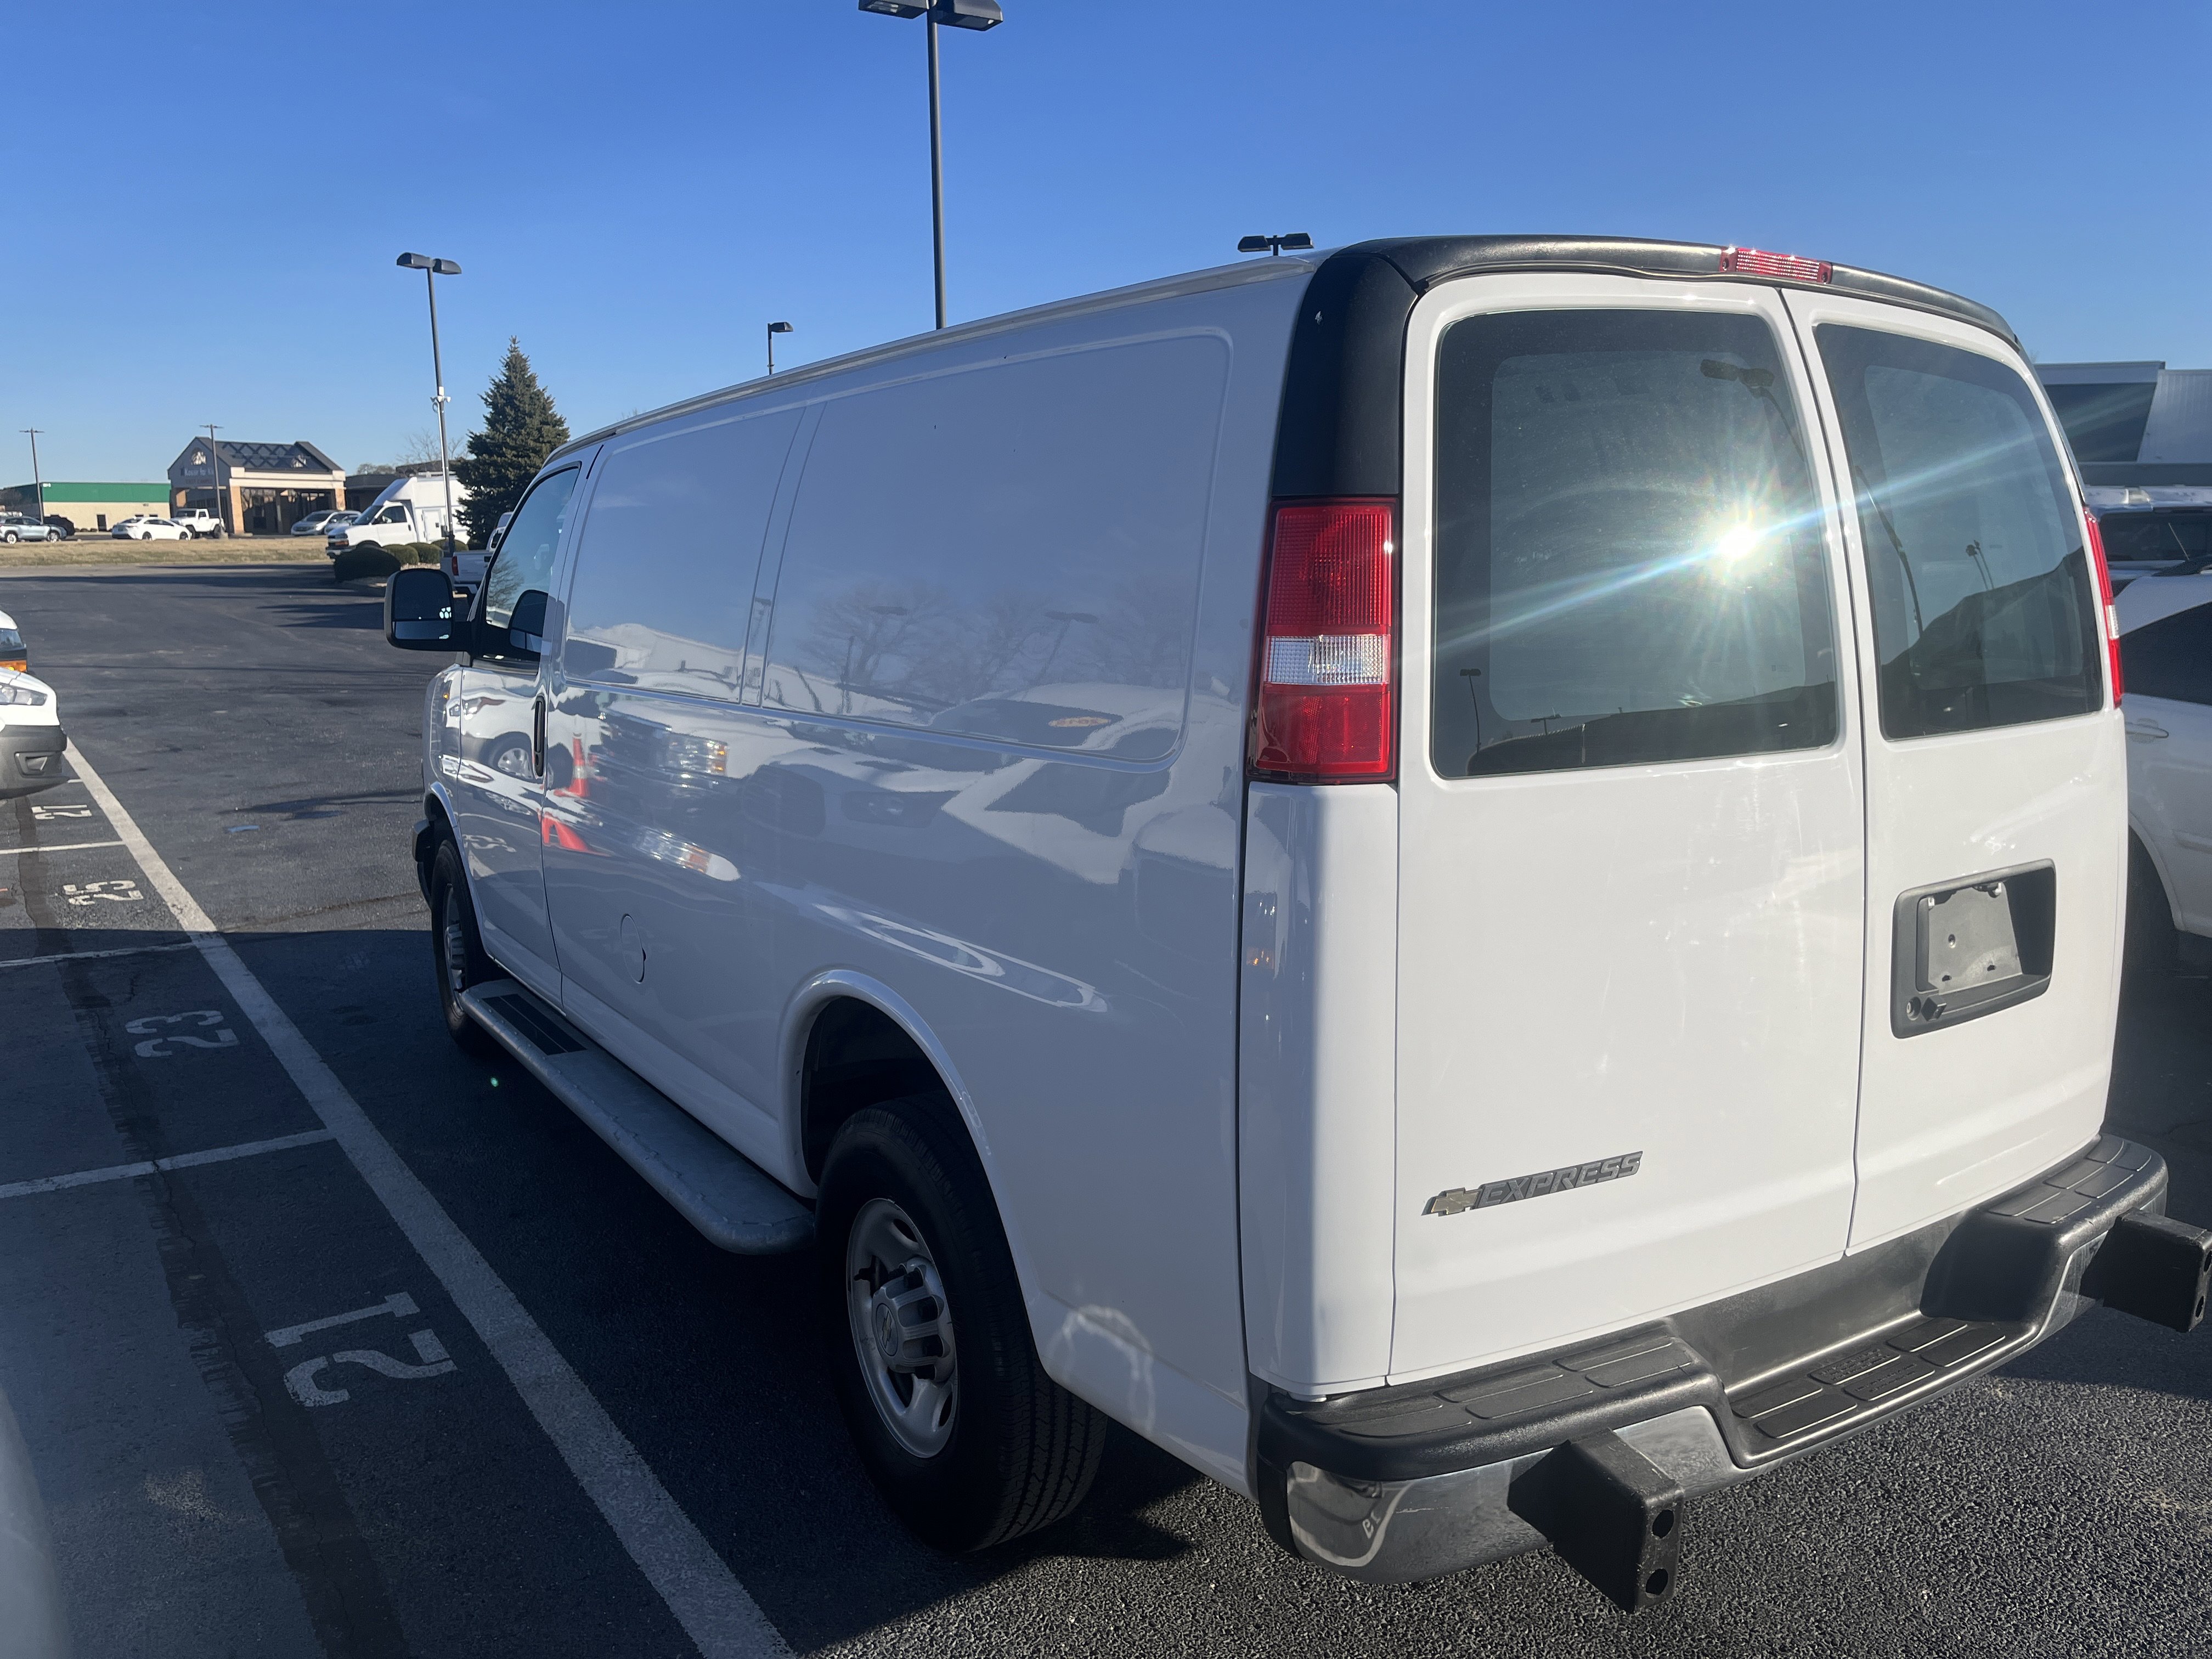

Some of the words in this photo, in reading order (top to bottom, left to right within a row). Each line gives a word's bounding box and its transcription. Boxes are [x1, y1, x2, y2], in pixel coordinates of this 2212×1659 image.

[63, 880, 144, 906] 25
[125, 1010, 240, 1058] 23
[1480, 1152, 1643, 1206] EXPRESS
[264, 1291, 458, 1407] 21
